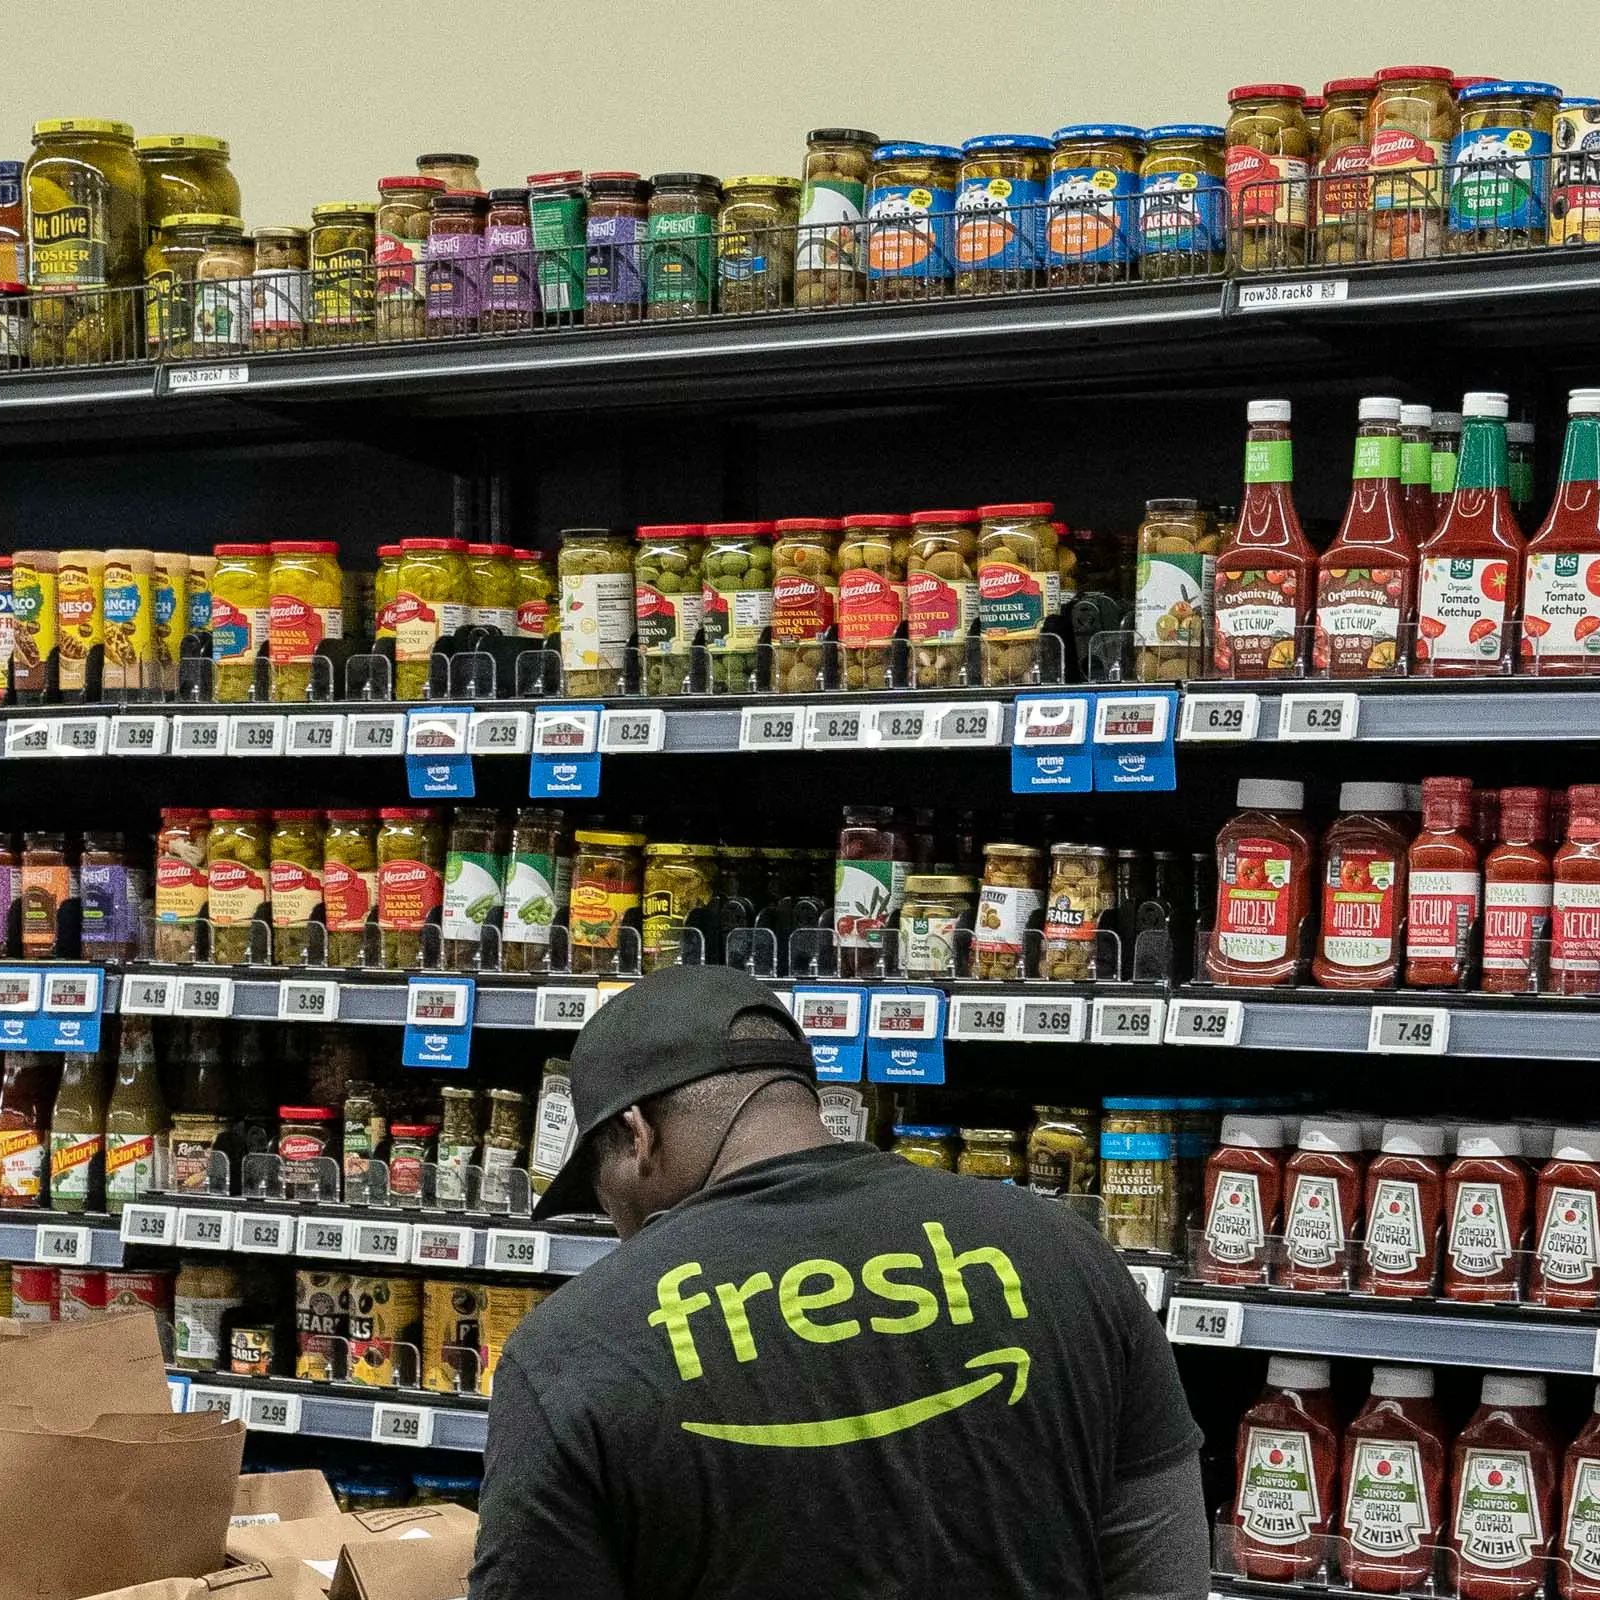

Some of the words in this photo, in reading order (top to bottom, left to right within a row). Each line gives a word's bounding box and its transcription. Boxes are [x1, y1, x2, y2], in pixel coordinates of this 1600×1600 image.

[51, 213, 86, 237] Olive
[34, 250, 89, 262] KOSHER
[40, 263, 78, 273] DILLS
[1242, 285, 1314, 302] row38.rack8
[1440, 593, 1480, 605] Tomato
[1544, 590, 1586, 602] Tomato
[1436, 606, 1482, 621] Ketchup
[1540, 603, 1587, 618] Ketchup
[1232, 615, 1274, 633] KETCHUP
[1333, 614, 1377, 632] KETCHUP
[1121, 710, 1140, 721] 4.49
[1209, 708, 1243, 727] 6.29
[1306, 709, 1342, 728] 6.29
[489, 724, 517, 744] 2.39
[620, 723, 649, 741] 8.29
[955, 716, 988, 734] 8.29
[128, 726, 153, 745] 3.99
[307, 725, 333, 745] 4.79
[380, 867, 427, 885] Mezzetta
[298, 994, 325, 1011] 3.99
[557, 1001, 585, 1018] 3.29
[974, 1010, 1005, 1029] 3.49
[1037, 1011, 1071, 1029] 3.69
[1117, 1014, 1150, 1031] 2.69
[1193, 1014, 1226, 1033] 9.29
[1397, 1022, 1433, 1041] 7.49
[1108, 1175, 1152, 1186] CLASSIC
[140, 1218, 164, 1235] 3.39
[507, 1244, 534, 1260] 3.99
[647, 1221, 1029, 1382] fresh
